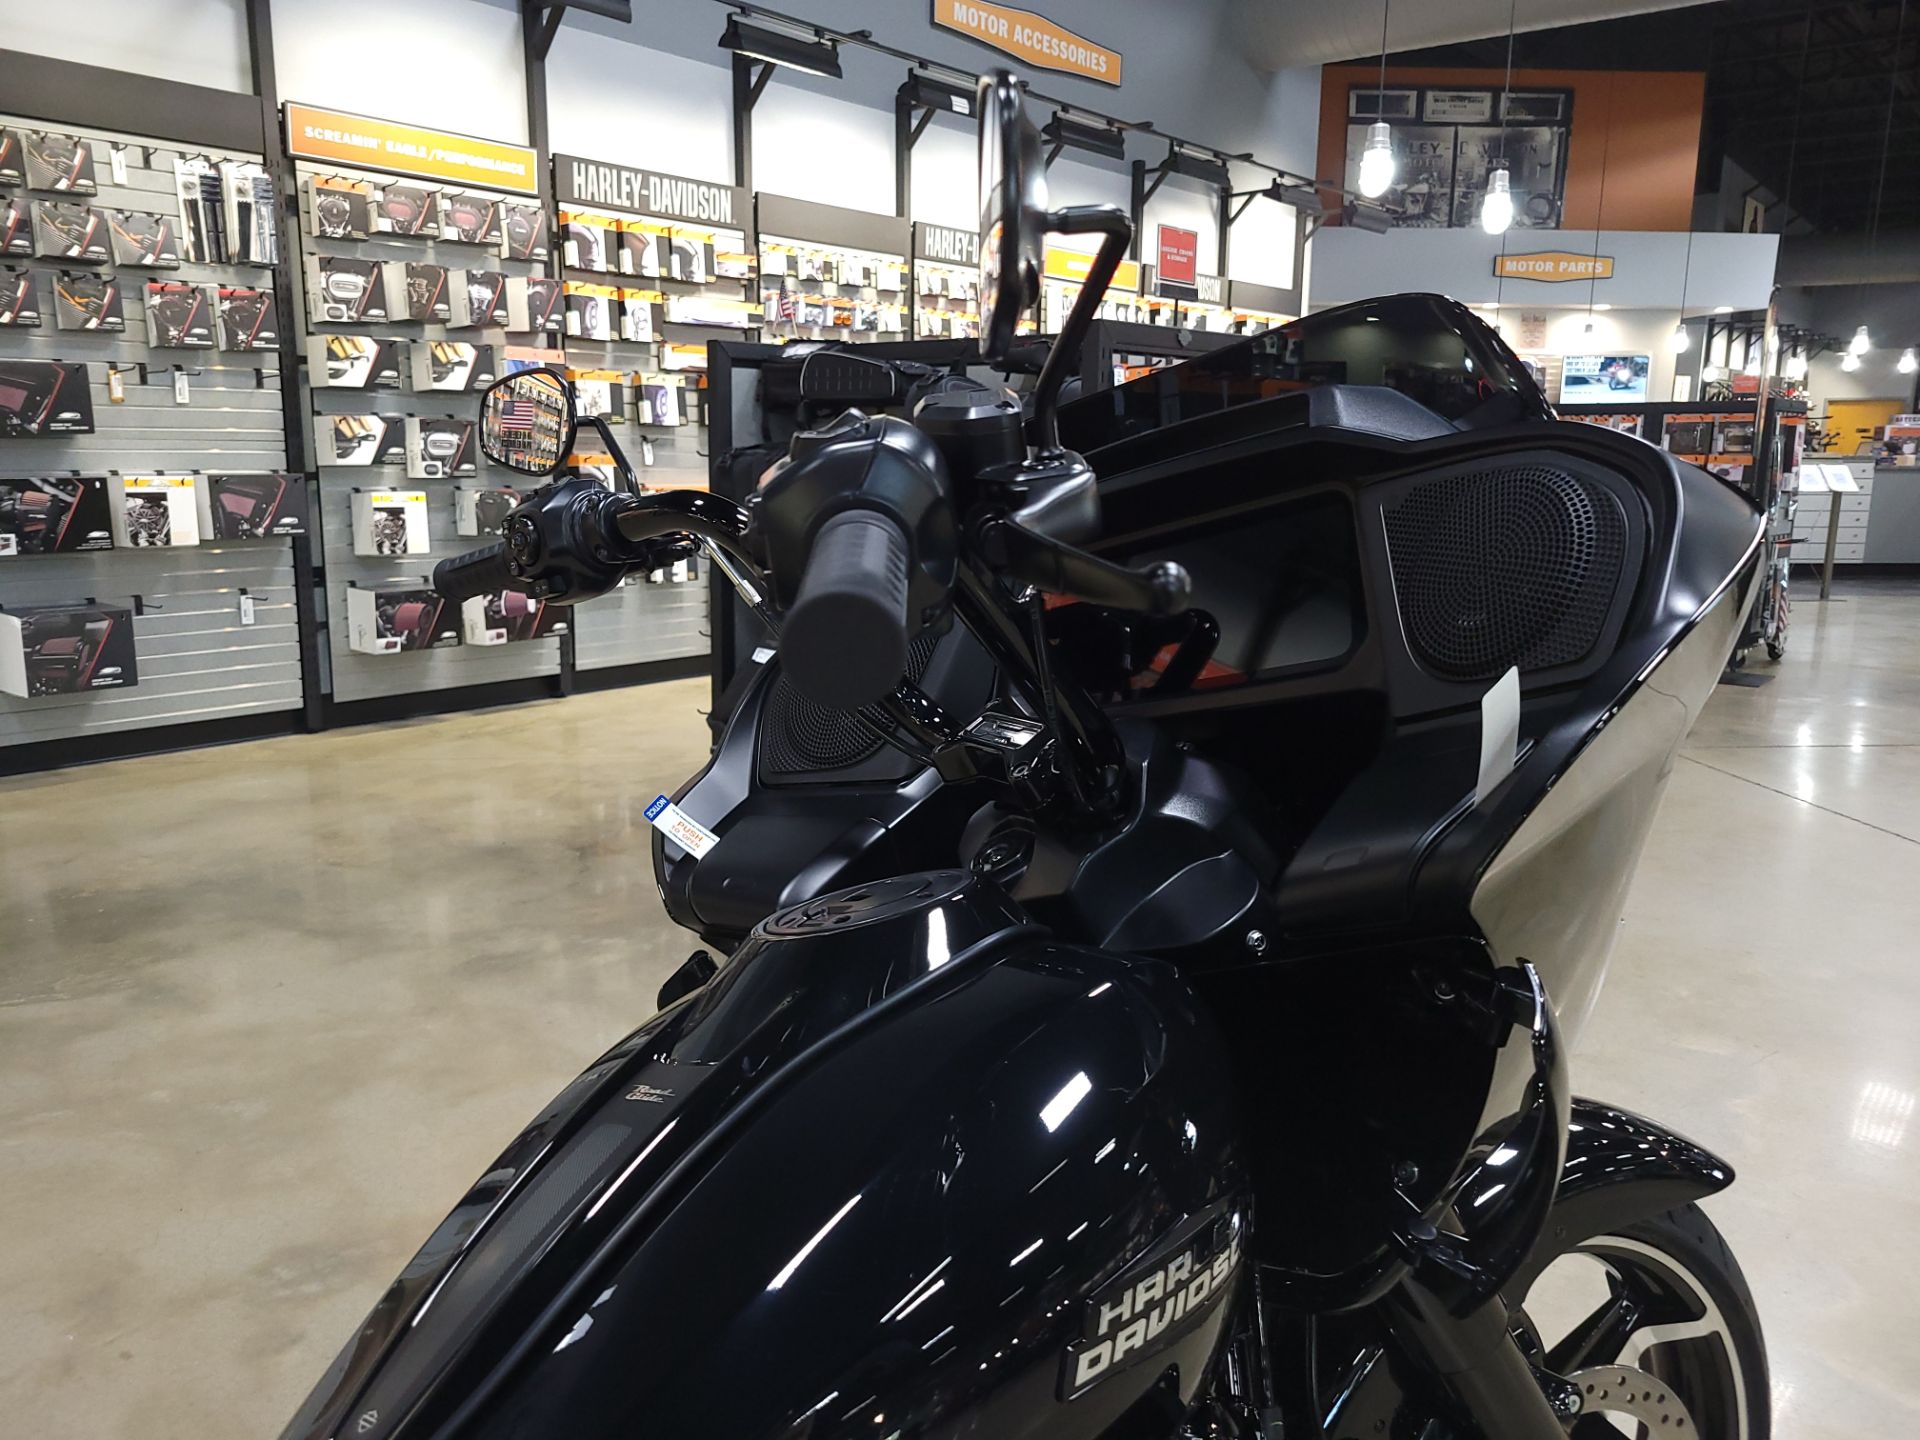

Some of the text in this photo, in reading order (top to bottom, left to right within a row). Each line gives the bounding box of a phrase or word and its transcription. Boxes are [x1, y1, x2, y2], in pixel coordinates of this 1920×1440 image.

[953, 2, 1107, 73] MOTOR ACCESSORIES
[572, 161, 732, 224] HARLEY-DAVIDSON
[1505, 260, 1603, 273] MOTOR PARTS
[646, 797, 667, 819] NOTICE
[677, 821, 704, 842] PUSH
[681, 833, 701, 849] OPEN
